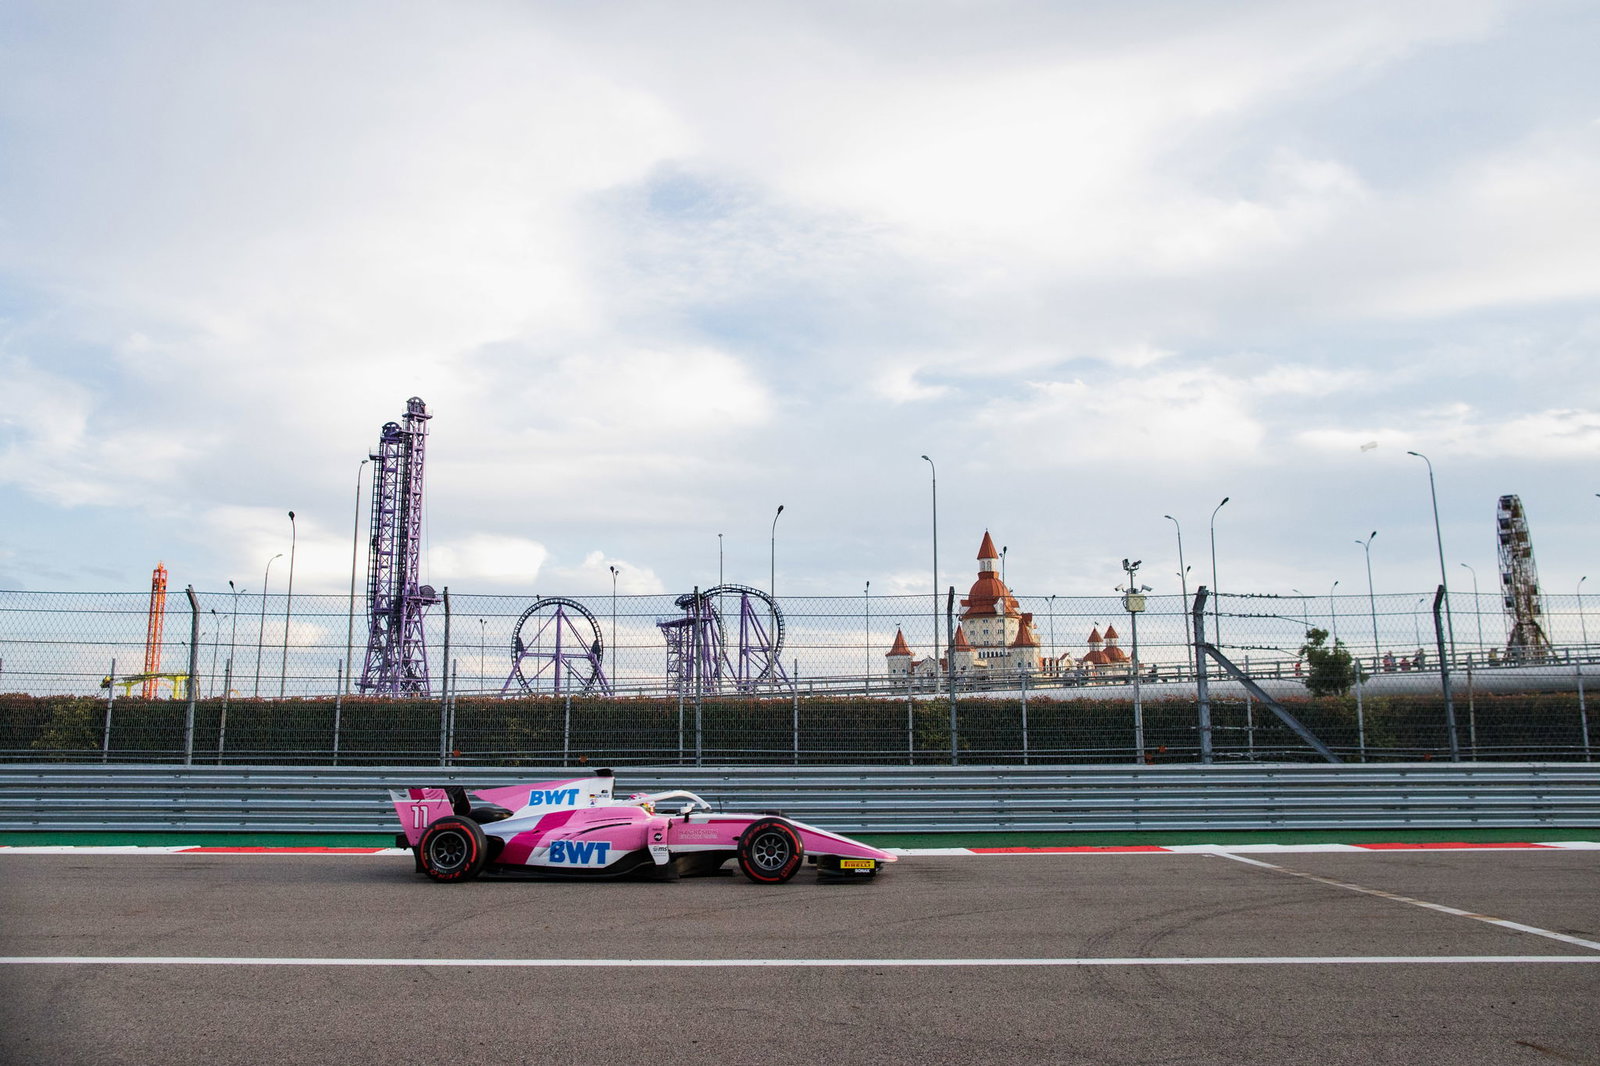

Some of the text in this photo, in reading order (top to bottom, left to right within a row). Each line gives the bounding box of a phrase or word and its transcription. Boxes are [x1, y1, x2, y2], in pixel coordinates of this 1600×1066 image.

[529, 789, 580, 806] BWT
[411, 805, 428, 829] 11
[548, 840, 611, 865] BWT
